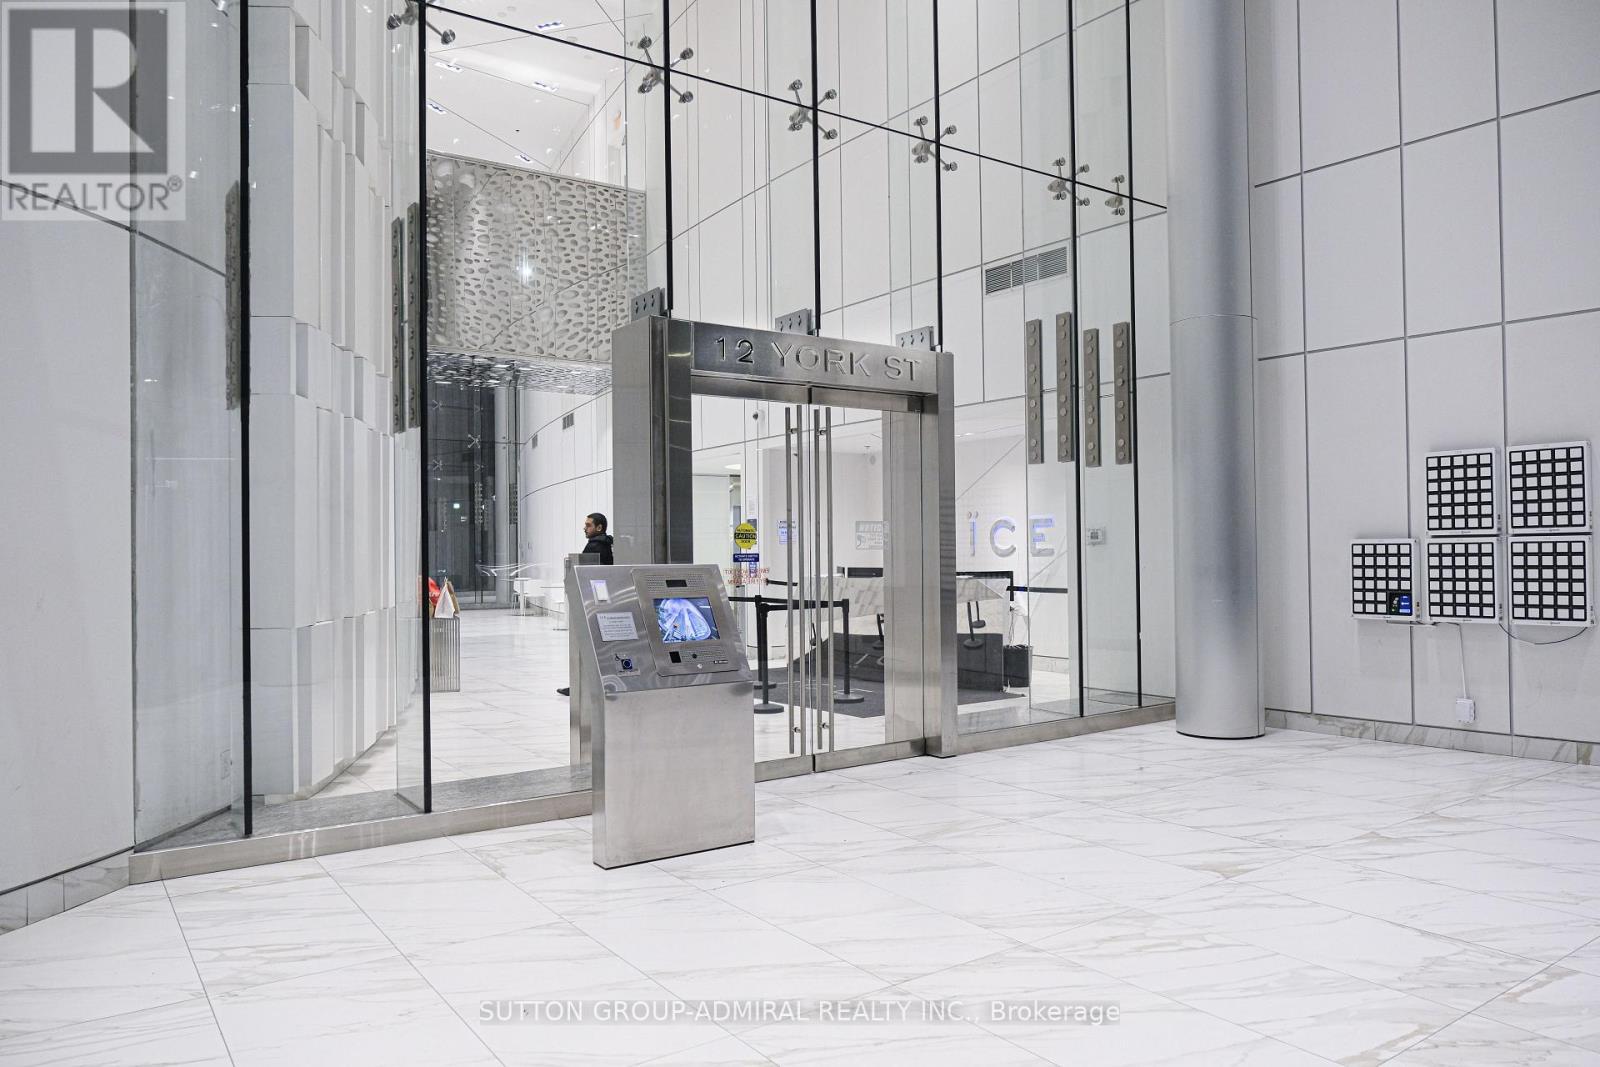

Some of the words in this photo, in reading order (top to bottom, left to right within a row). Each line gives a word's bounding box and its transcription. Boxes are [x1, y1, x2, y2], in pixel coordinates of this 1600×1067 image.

[714, 335, 755, 365] 12
[770, 341, 871, 378] YORK
[883, 354, 921, 382] ST
